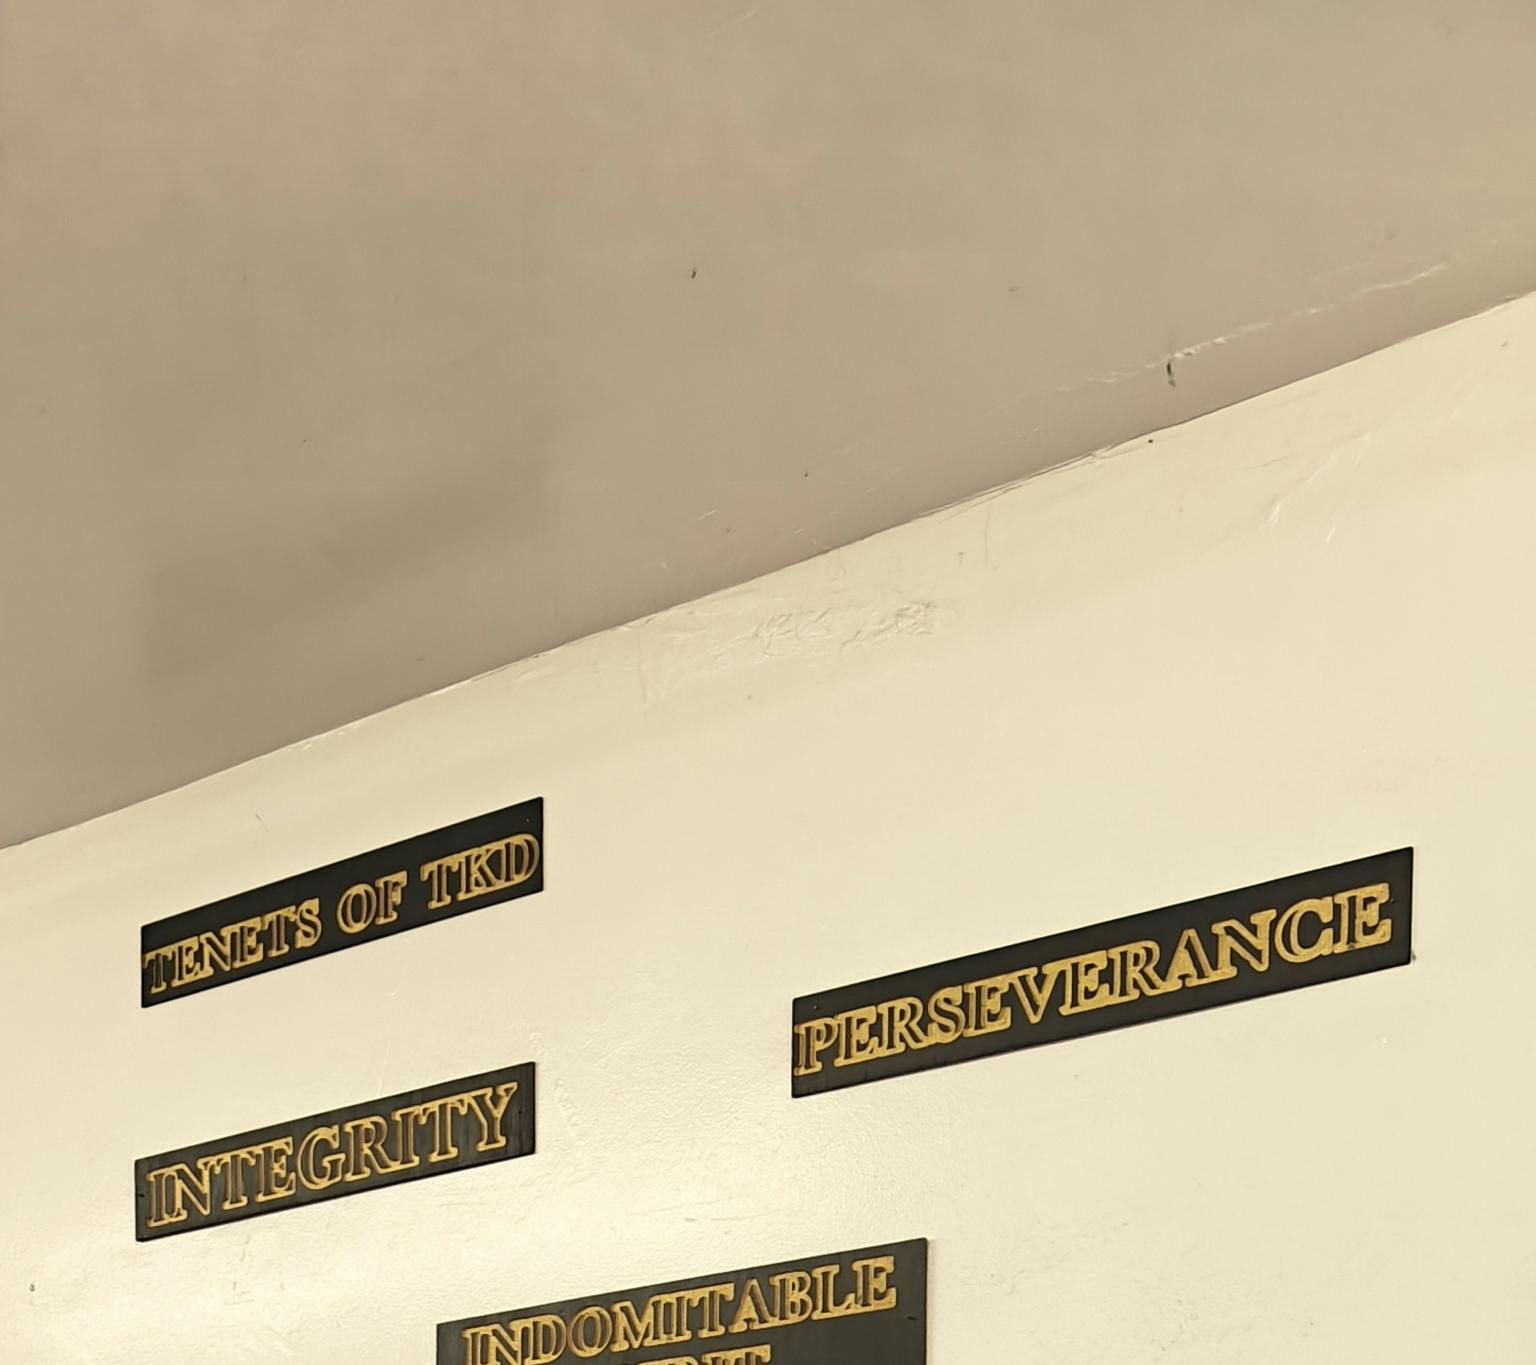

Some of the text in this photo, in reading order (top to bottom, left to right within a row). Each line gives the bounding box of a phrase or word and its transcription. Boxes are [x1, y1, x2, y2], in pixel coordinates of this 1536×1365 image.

[143, 833, 540, 994] TENETS OF TKD
[794, 882, 1392, 1076] PERSEVERANCE
[146, 1081, 518, 1227] INTEGRITY
